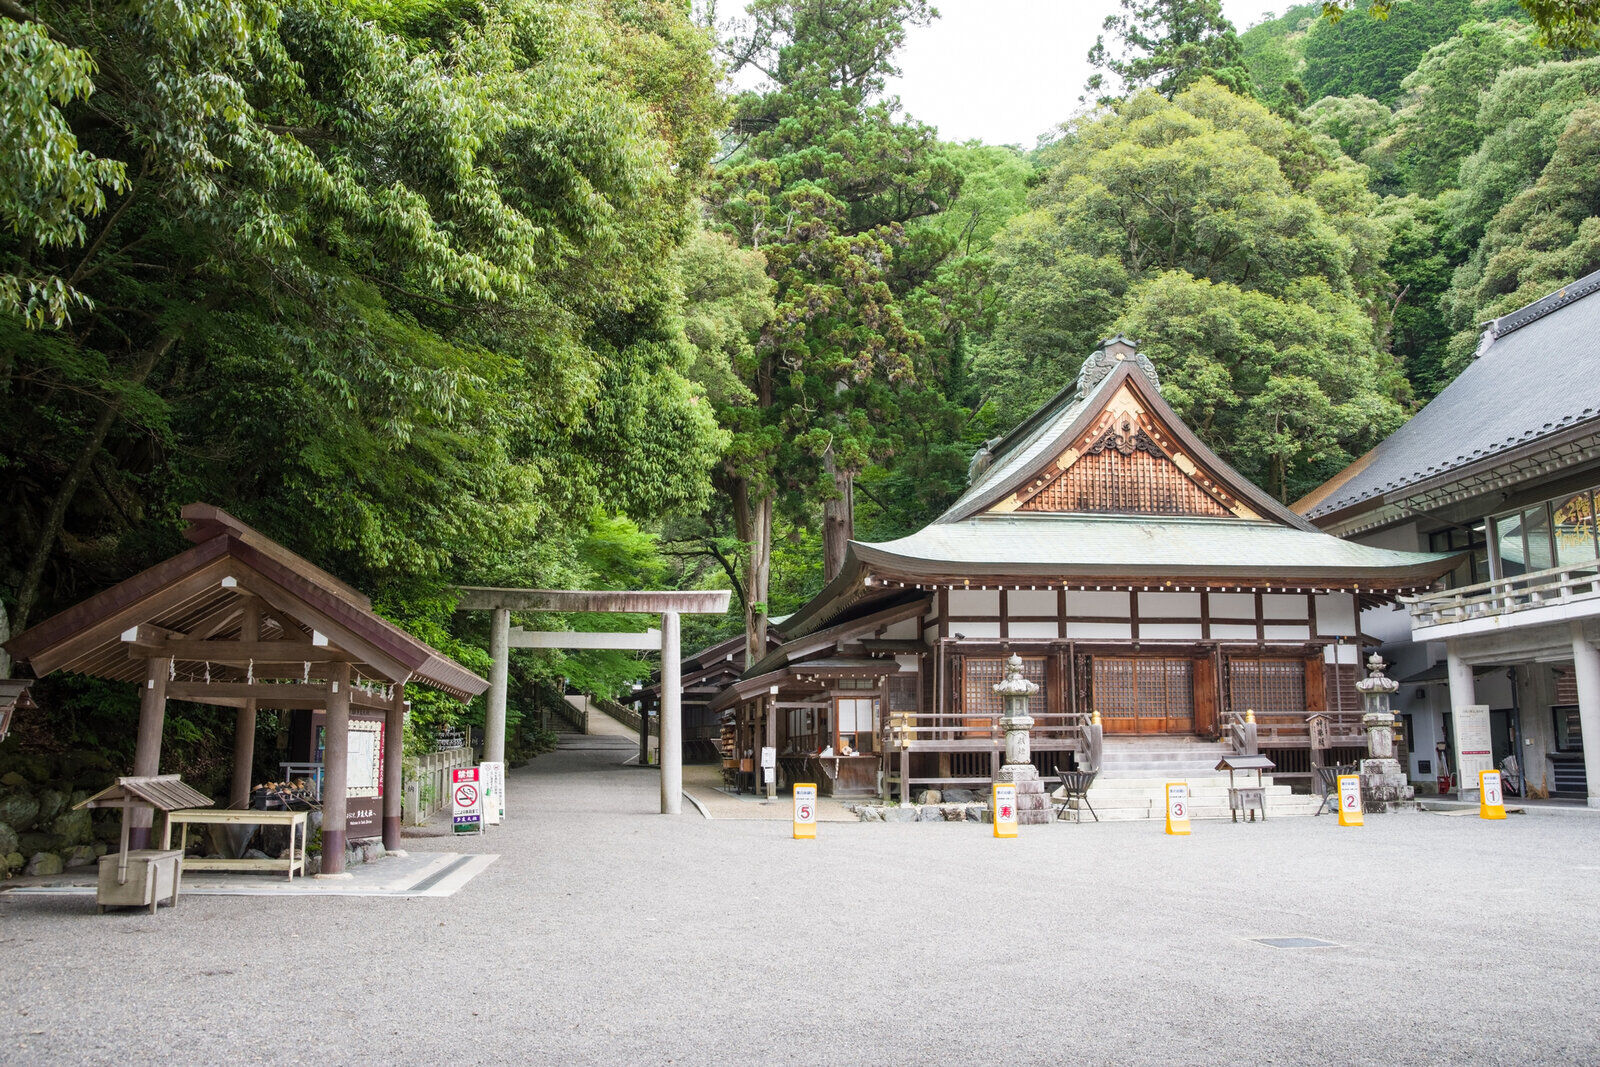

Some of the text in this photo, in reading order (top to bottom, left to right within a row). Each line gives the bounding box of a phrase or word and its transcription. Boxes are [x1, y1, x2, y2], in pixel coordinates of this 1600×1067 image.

[1347, 795, 1355, 808] 2
[1489, 790, 1495, 801] 1
[800, 806, 810, 819] 5
[1000, 806, 1012, 818] 寿
[1174, 803, 1183, 816] 3
